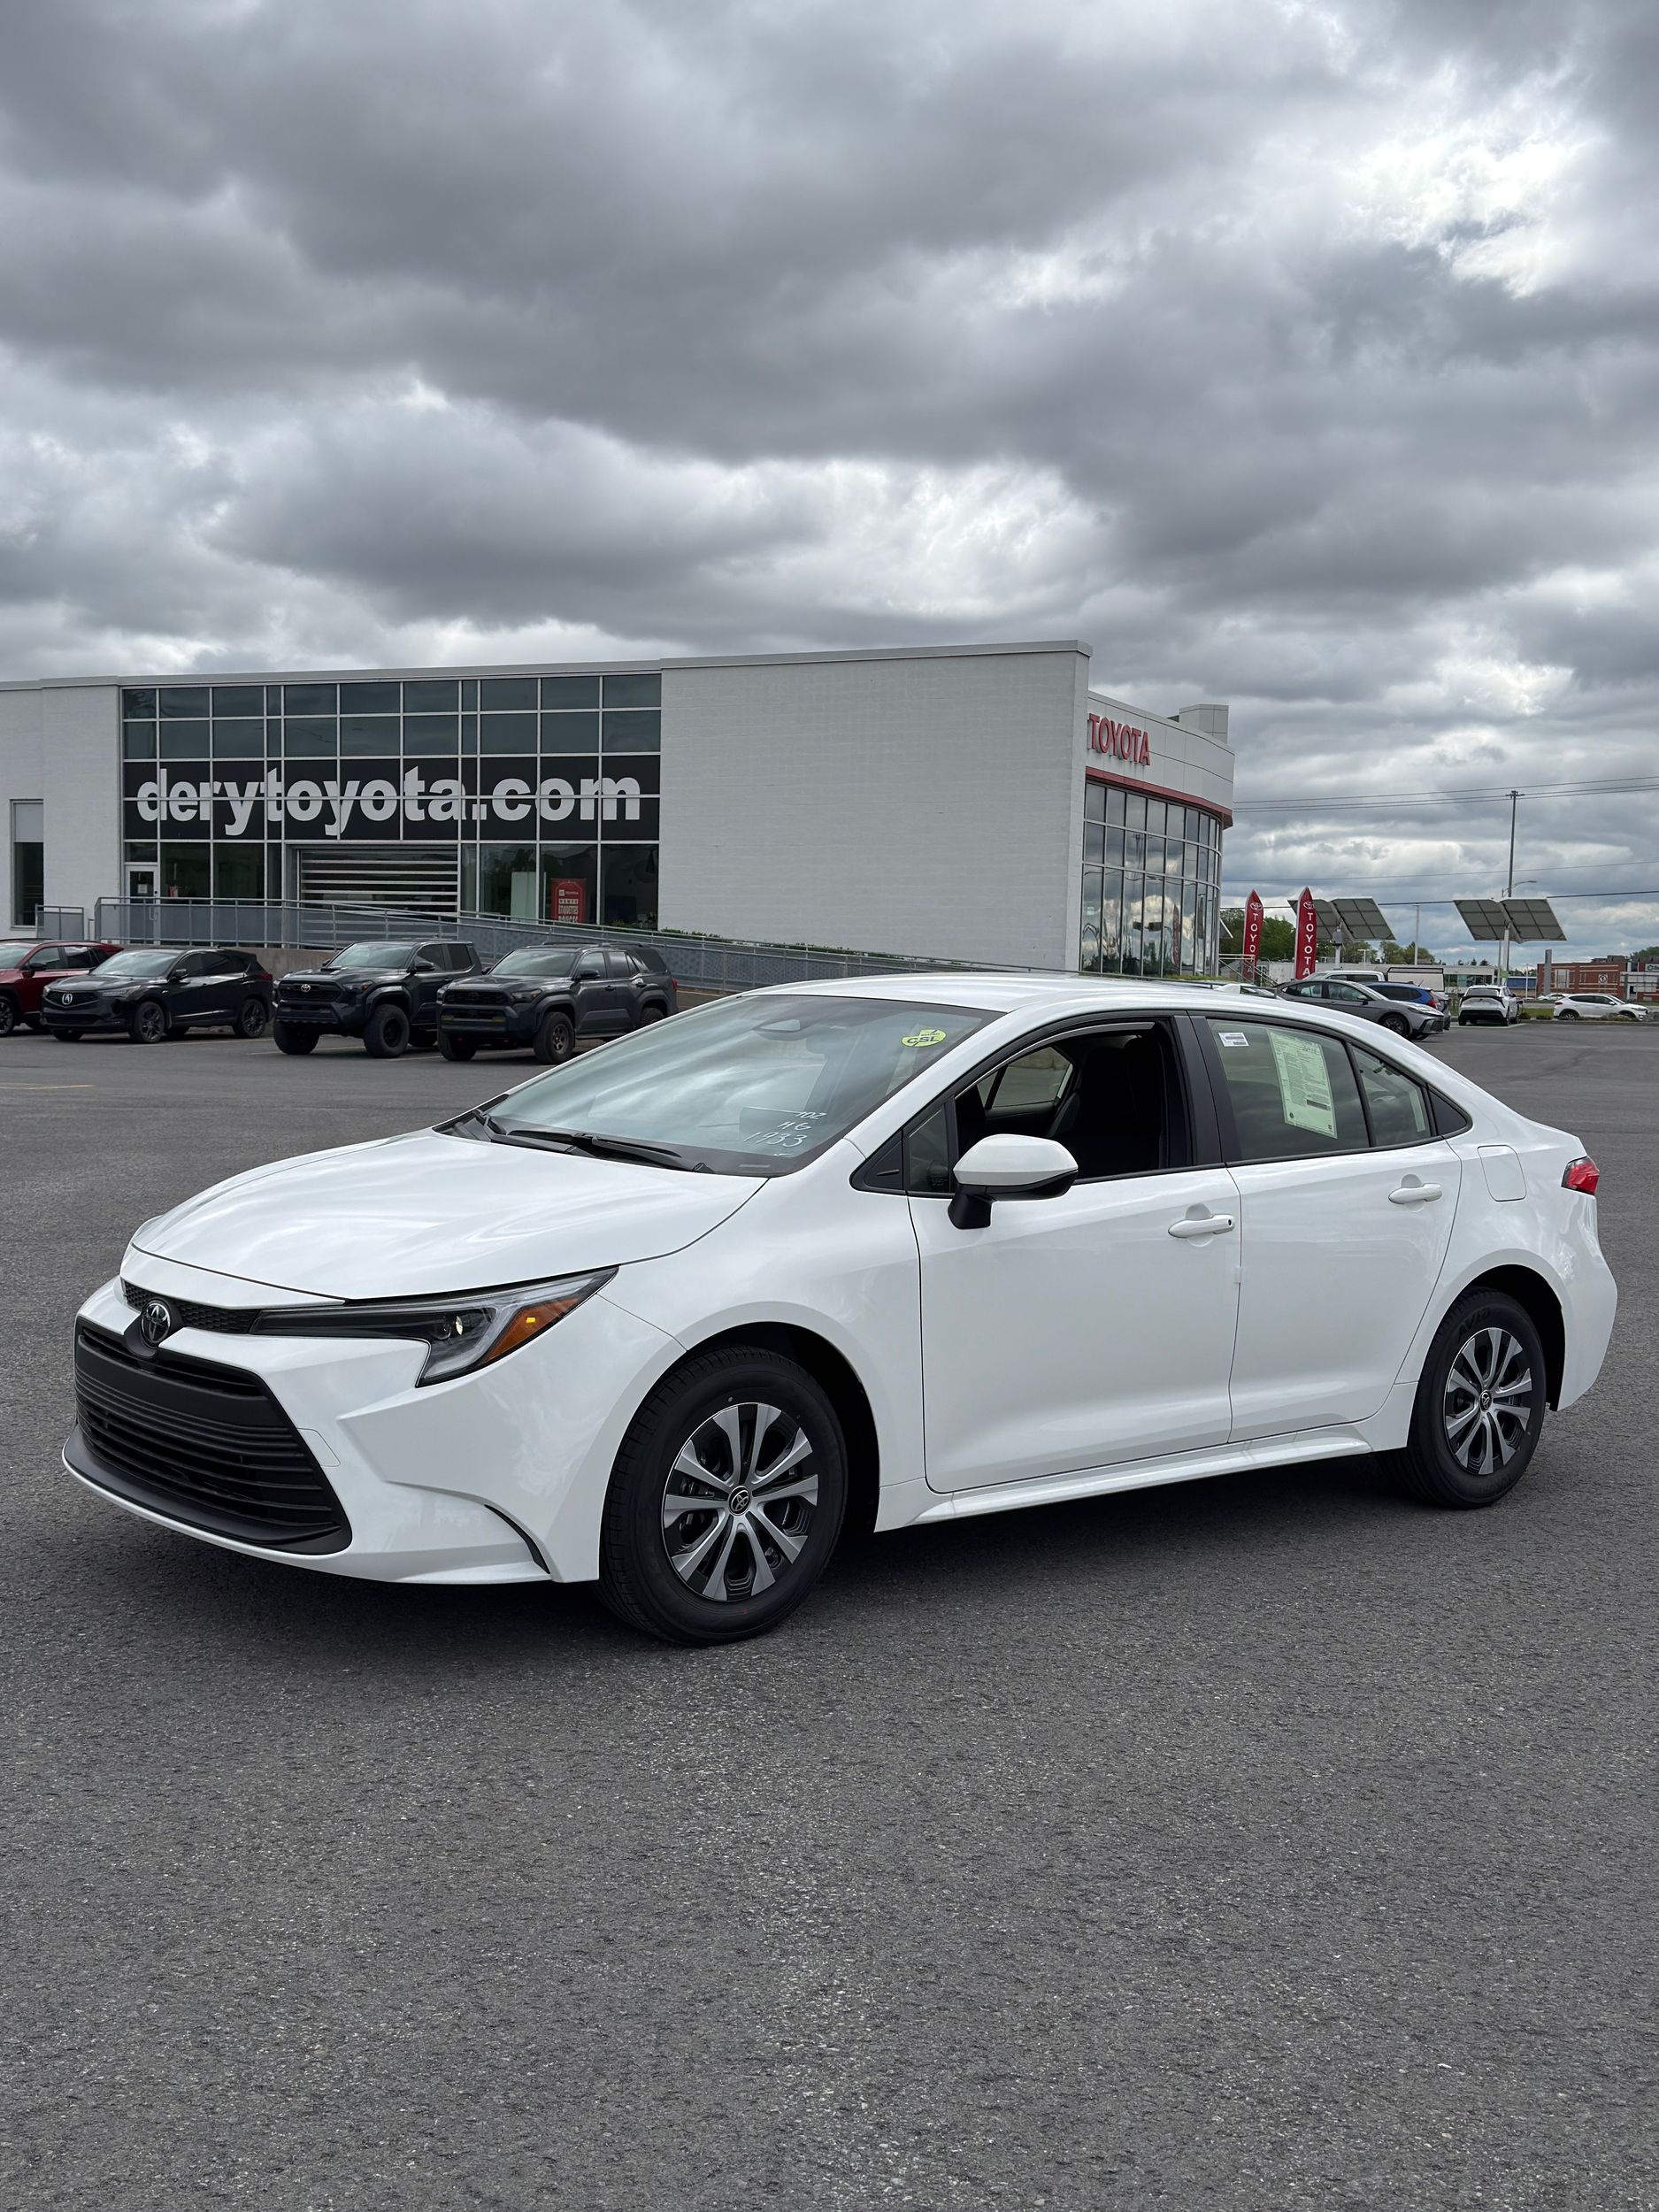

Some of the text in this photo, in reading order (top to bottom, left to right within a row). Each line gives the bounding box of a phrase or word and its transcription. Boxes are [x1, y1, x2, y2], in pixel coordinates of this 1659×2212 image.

[1088, 712, 1150, 765] TOYOTA
[137, 765, 640, 836] derytoyota.com
[1302, 912, 1314, 976] TOYOTA
